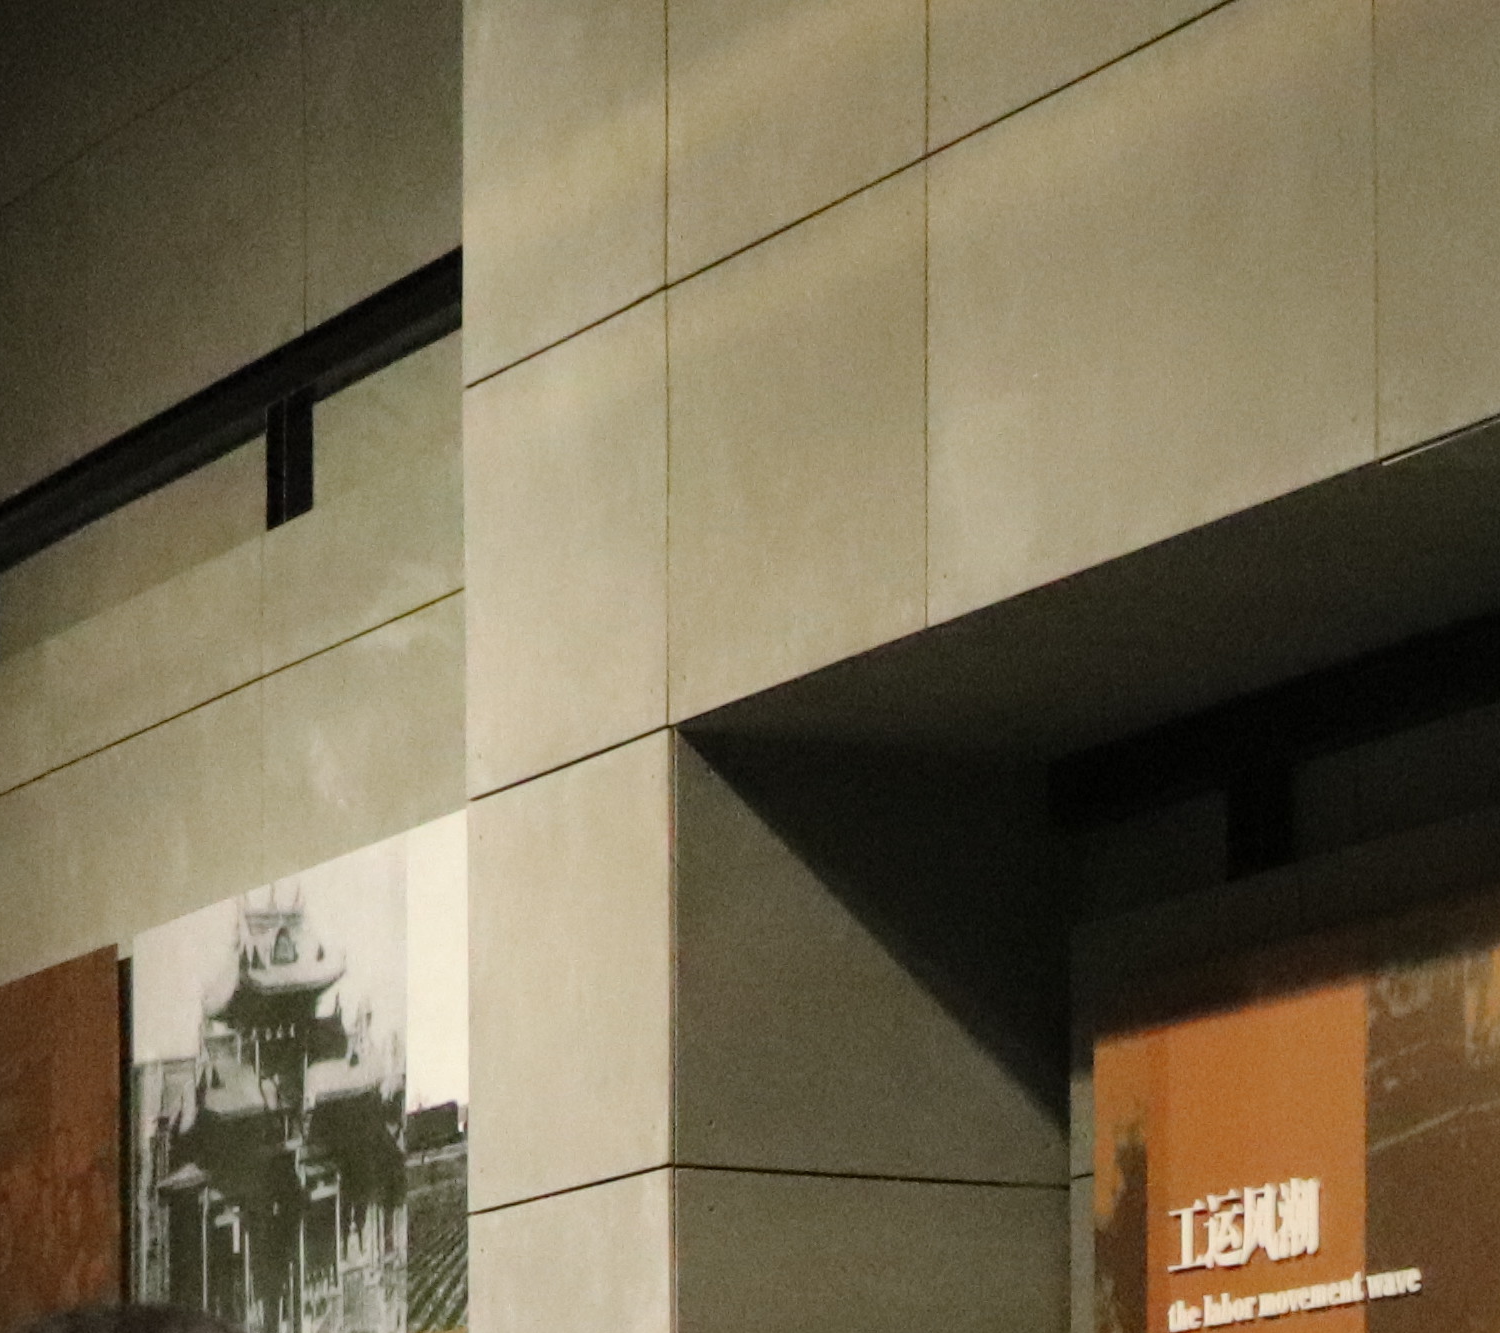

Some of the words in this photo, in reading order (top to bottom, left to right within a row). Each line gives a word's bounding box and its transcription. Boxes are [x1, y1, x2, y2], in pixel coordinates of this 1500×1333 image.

[1167, 1177, 1320, 1272] 工运风潮
[1168, 1300, 1202, 1333] the
[1203, 1293, 1257, 1328] labor
[1258, 1272, 1364, 1319] movement
[1365, 1267, 1422, 1299] wave
